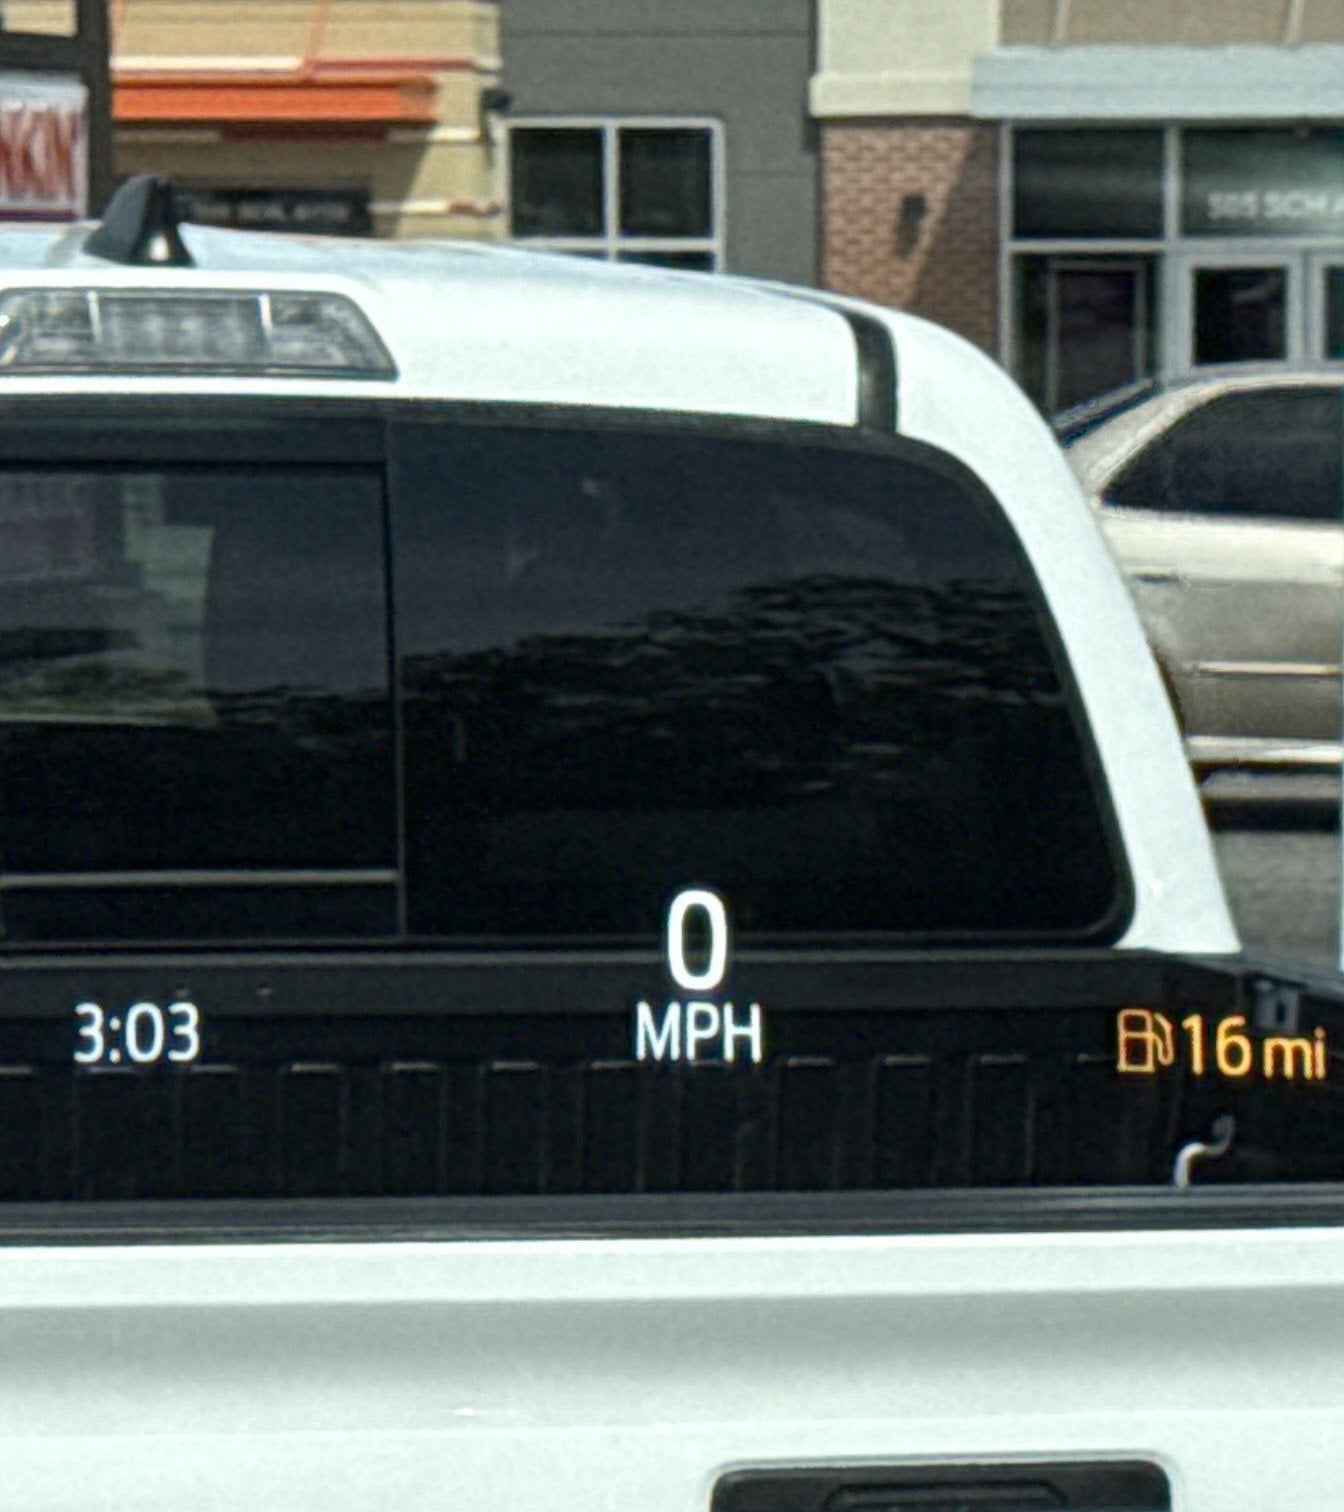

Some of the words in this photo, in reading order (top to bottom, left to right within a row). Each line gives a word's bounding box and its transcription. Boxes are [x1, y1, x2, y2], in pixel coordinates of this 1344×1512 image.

[668, 890, 727, 990] 0
[74, 1003, 199, 1063] 3:03
[635, 1001, 762, 1063] MPH
[1182, 1014, 1252, 1077] 16
[1263, 1027, 1327, 1080] mi
